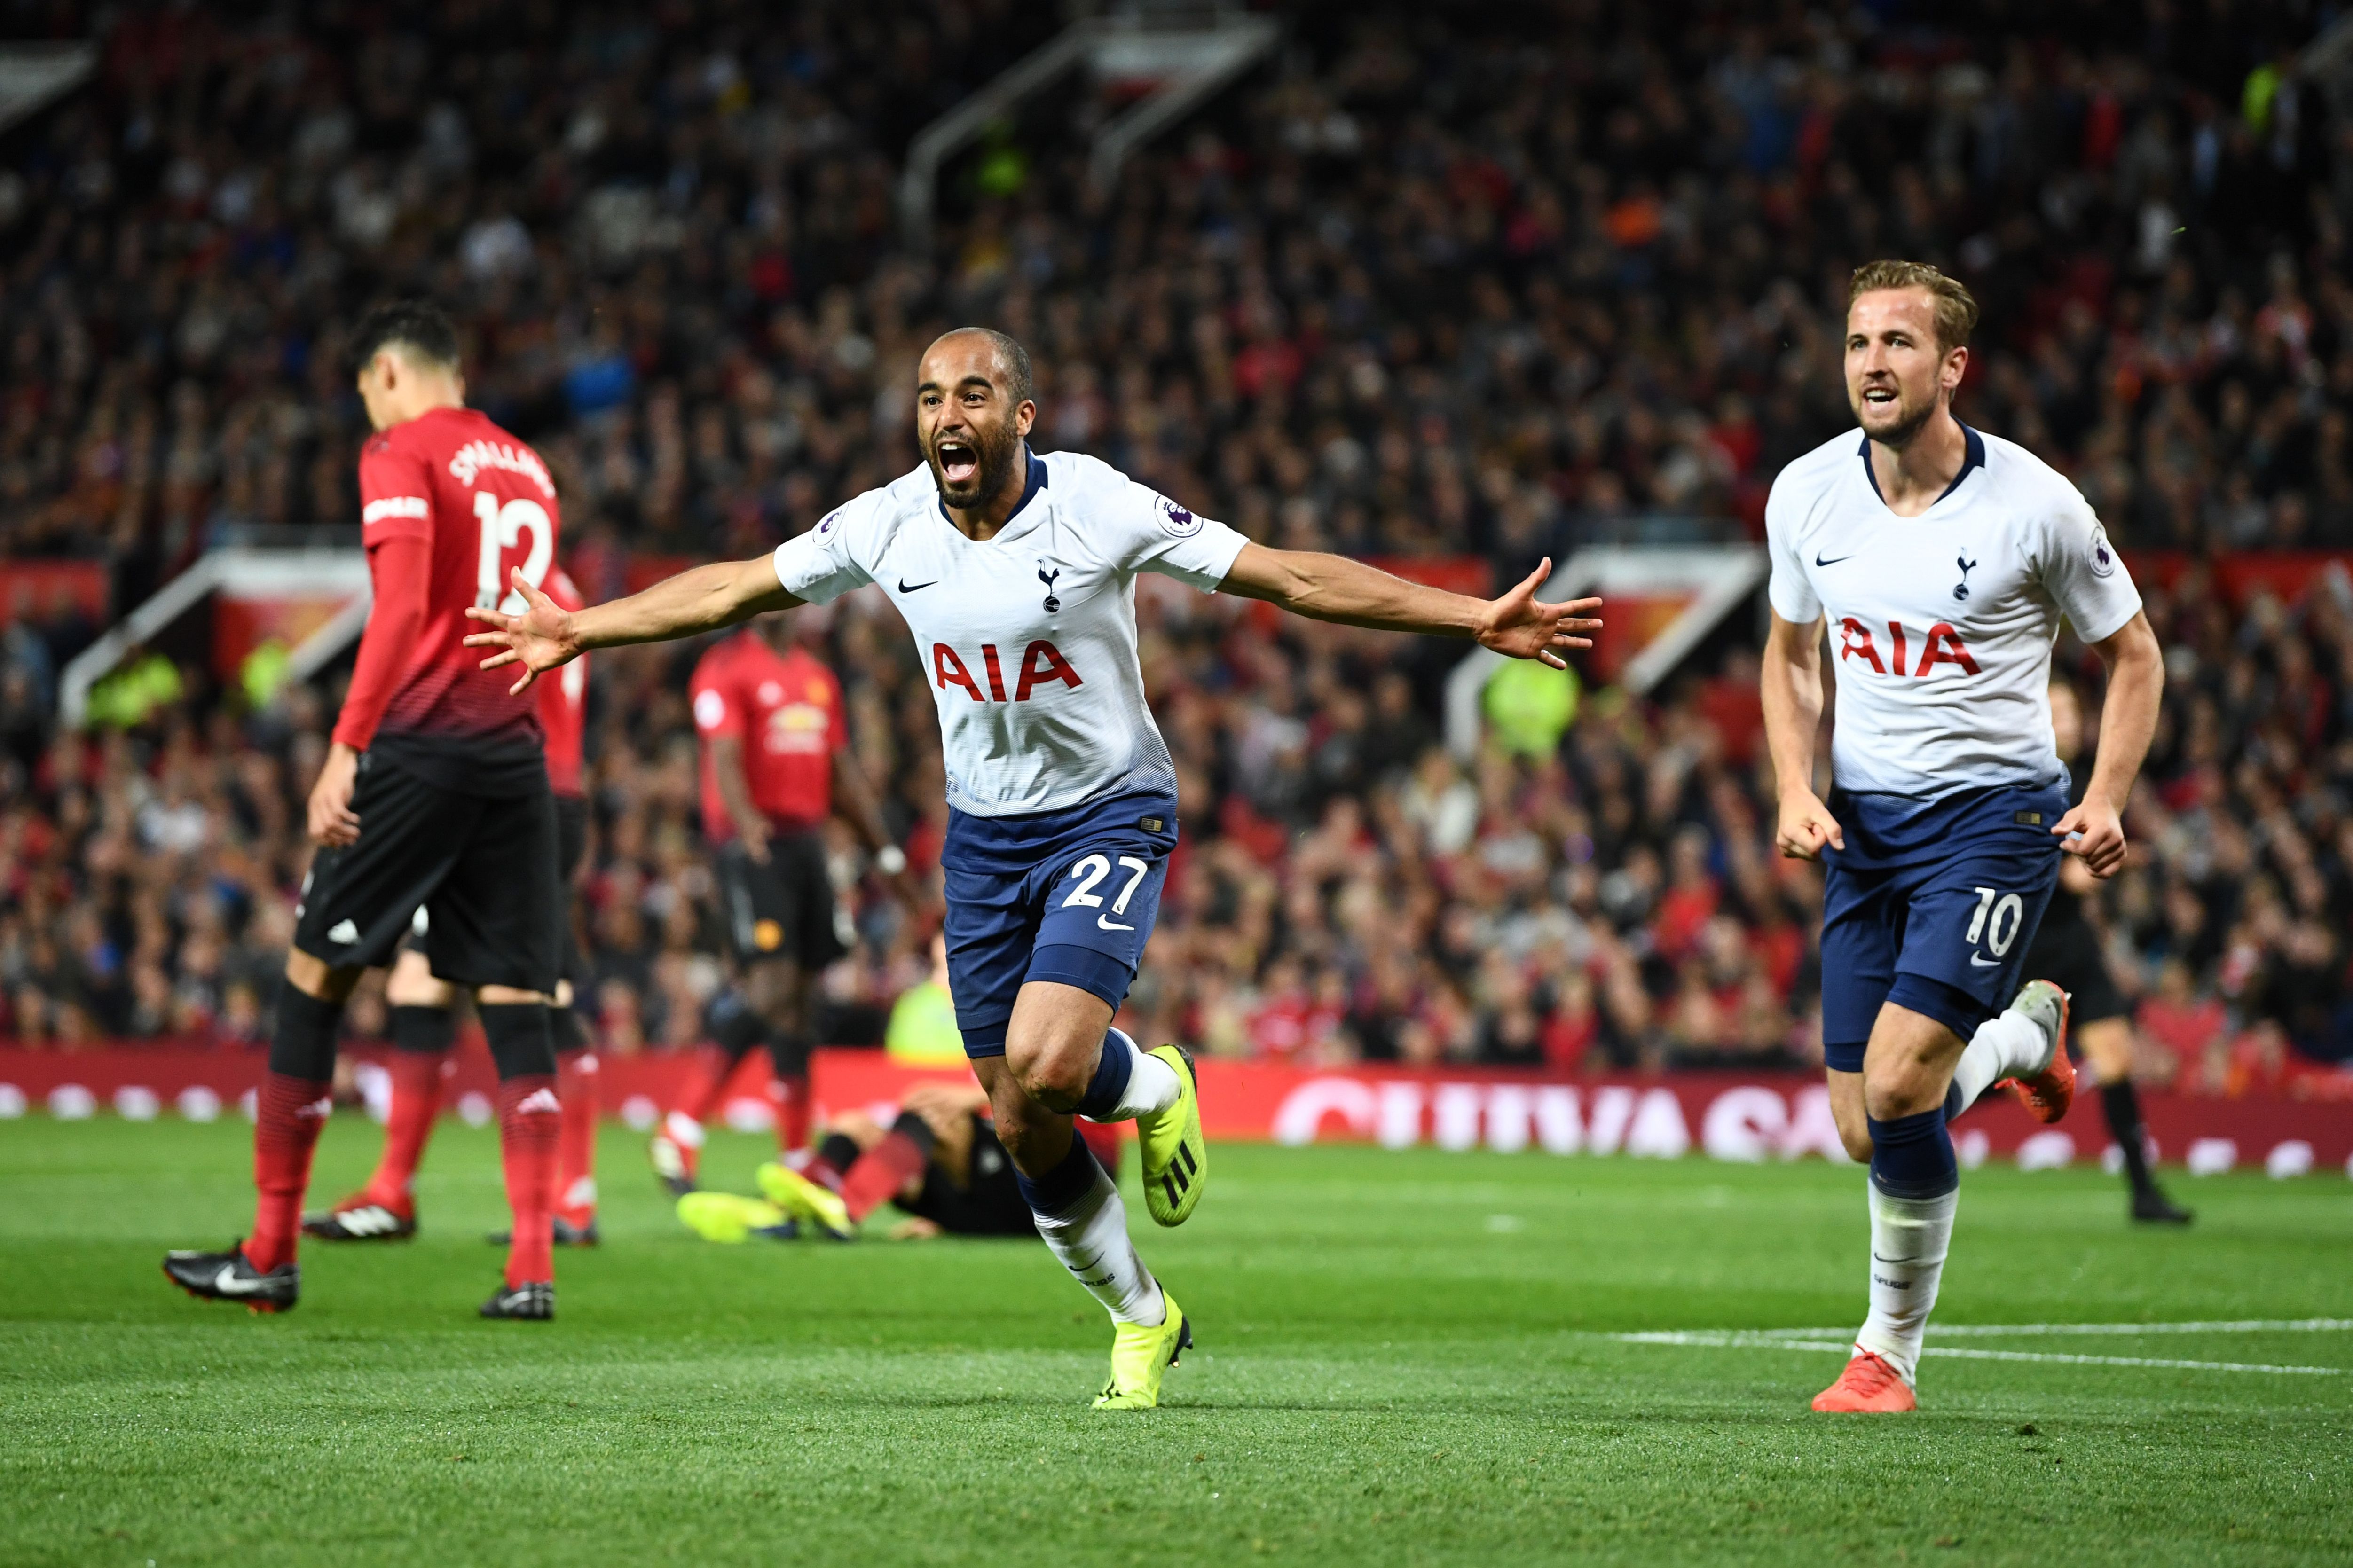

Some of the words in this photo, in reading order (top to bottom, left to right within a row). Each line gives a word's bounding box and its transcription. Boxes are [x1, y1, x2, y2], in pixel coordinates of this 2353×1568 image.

[473, 491, 553, 615] 12
[933, 640, 1083, 702] AIA
[1840, 617, 1982, 677] AIA
[1061, 854, 1148, 916] 27
[1965, 887, 2022, 957] 10
[1078, 1273, 1115, 1287] SPURS
[1874, 1274, 1910, 1290] SPURS
